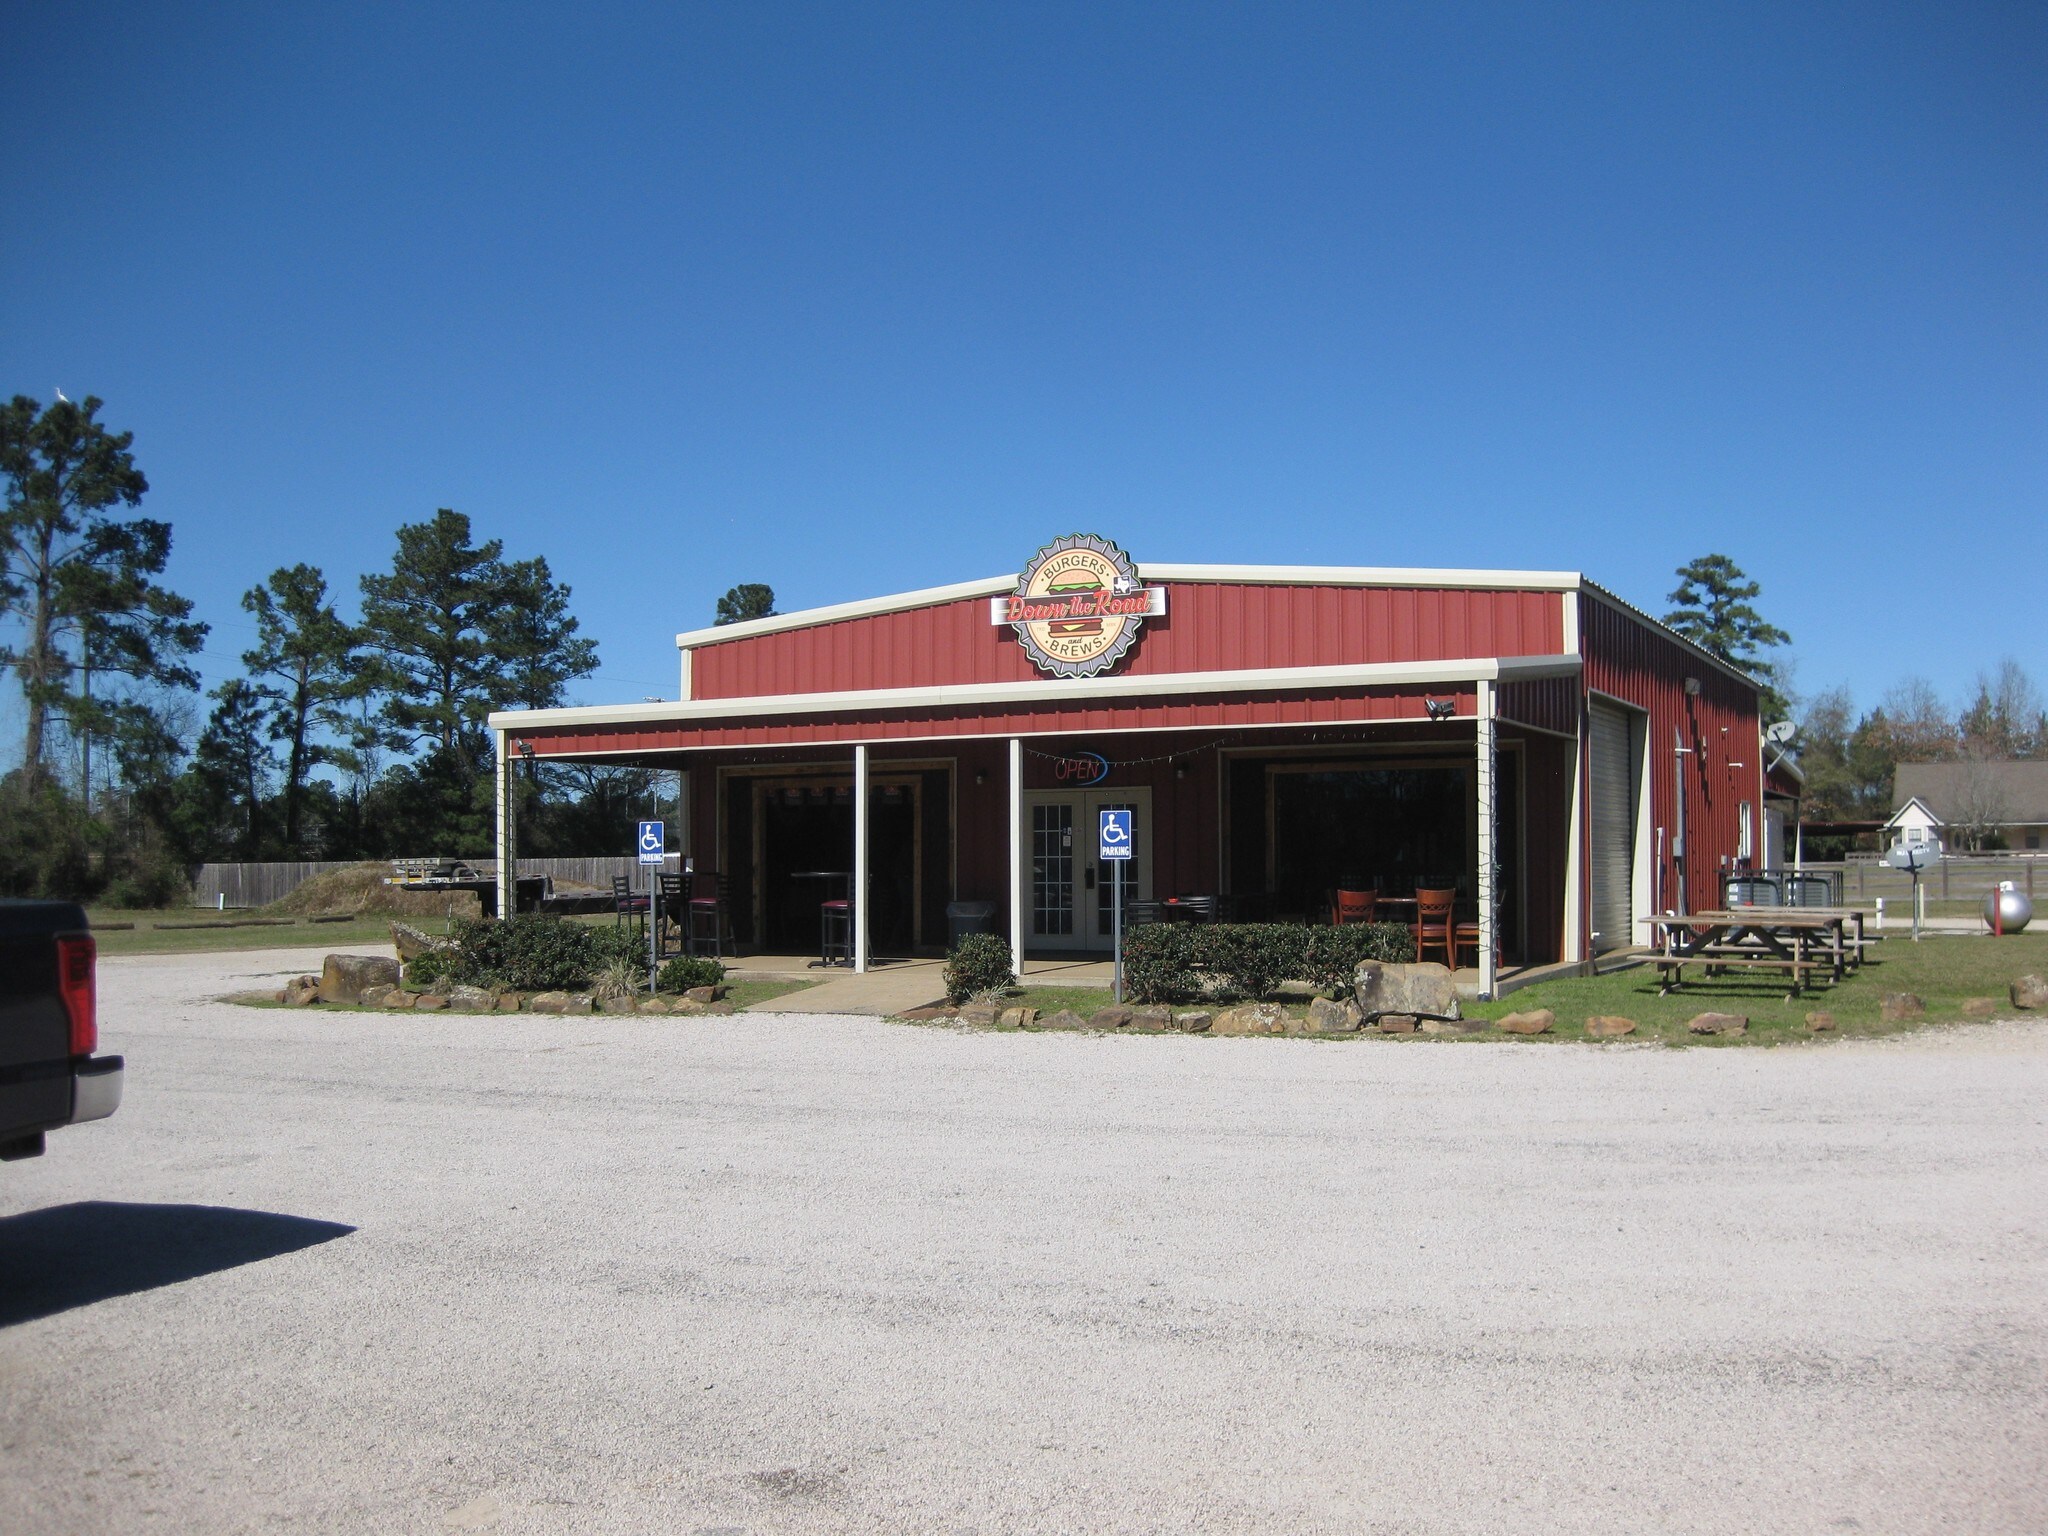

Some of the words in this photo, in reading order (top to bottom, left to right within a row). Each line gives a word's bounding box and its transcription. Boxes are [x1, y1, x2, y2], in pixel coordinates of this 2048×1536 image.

[1043, 555, 1108, 580] BURGERS
[1007, 595, 1068, 621] Down
[1070, 596, 1093, 616] the
[1093, 589, 1151, 617] Road
[1049, 637, 1103, 657] BREWS
[1067, 636, 1083, 645] and
[1055, 759, 1100, 780] OPEN
[641, 853, 663, 862] PARKING
[1102, 846, 1130, 856] PARKING
